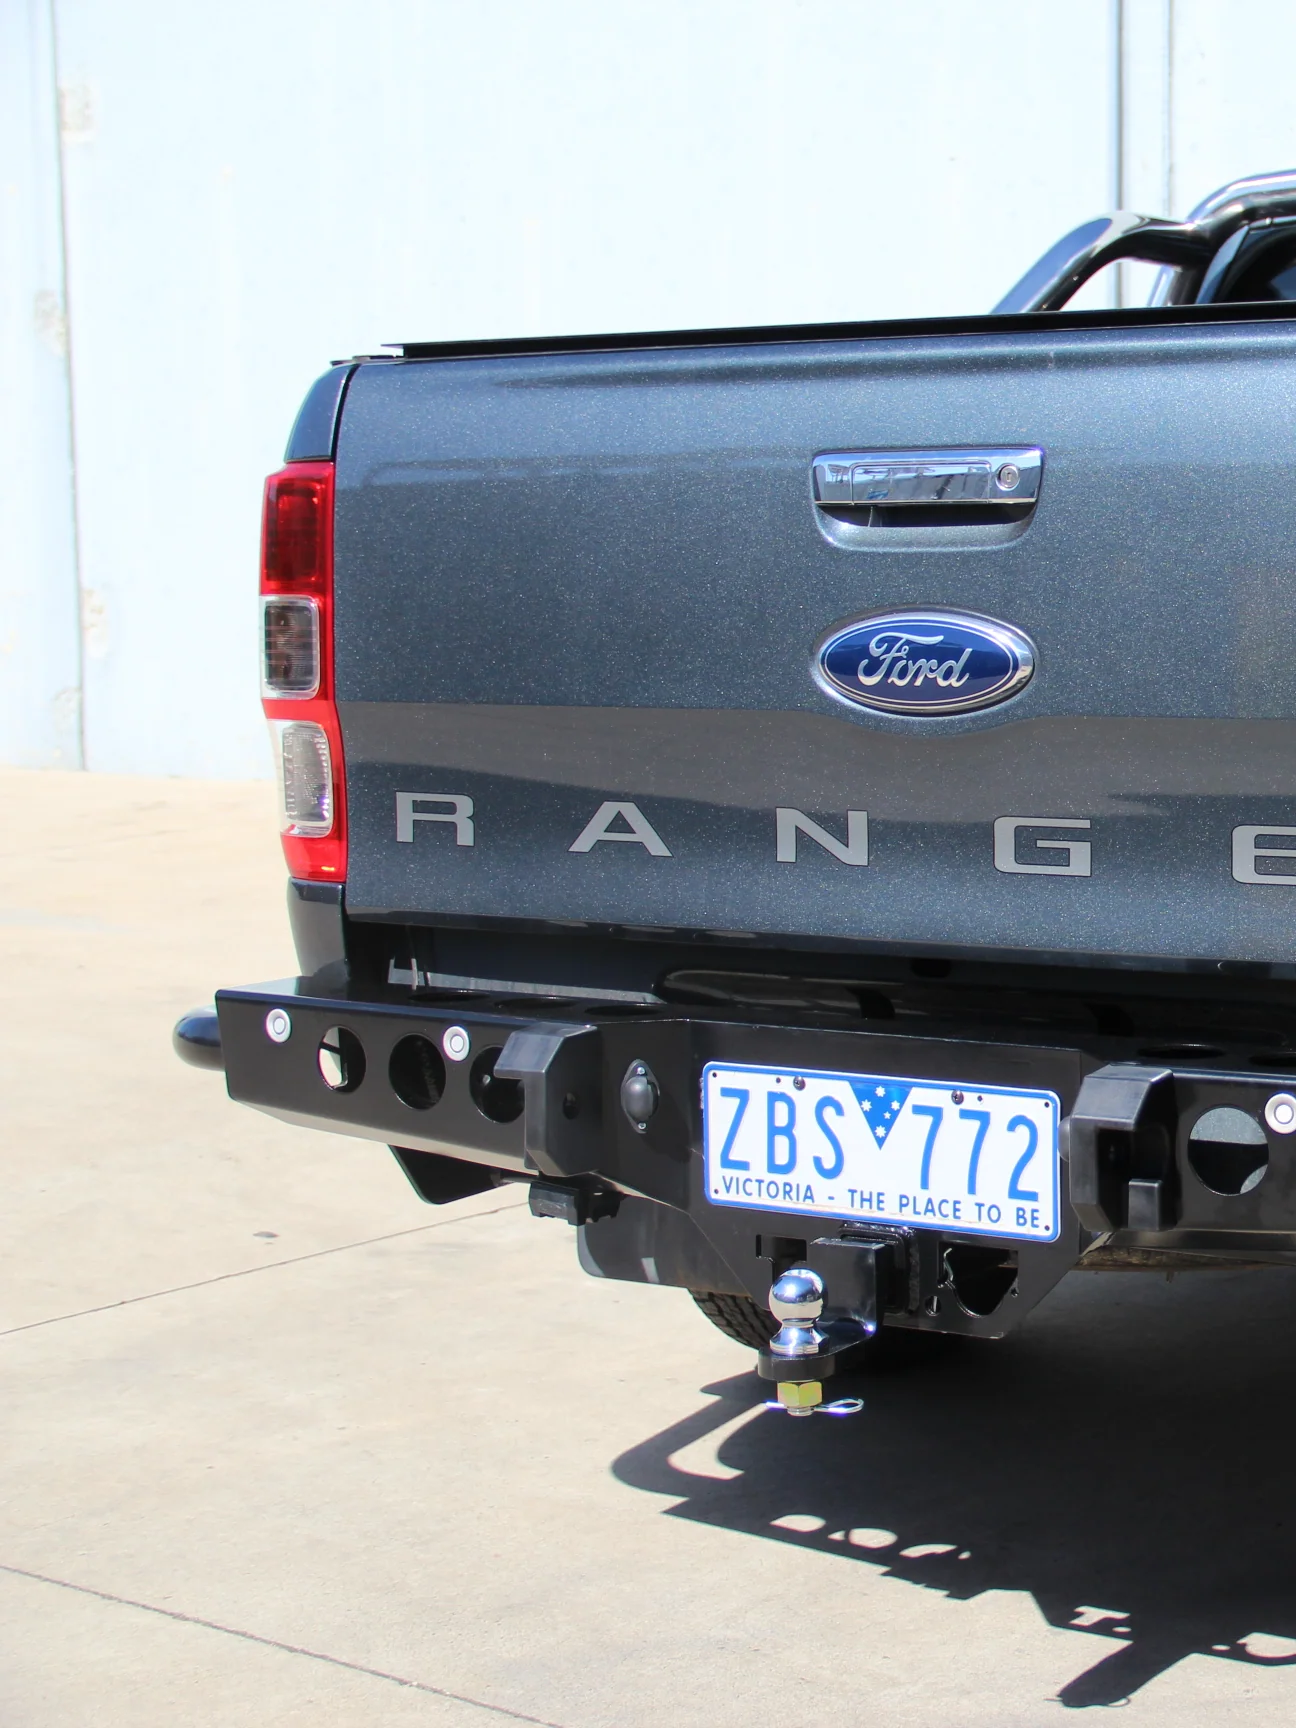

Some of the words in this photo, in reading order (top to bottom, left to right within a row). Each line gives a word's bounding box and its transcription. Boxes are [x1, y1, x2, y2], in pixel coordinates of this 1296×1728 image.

[857, 631, 973, 688] Ford
[719, 1086, 845, 1180] ZBS
[911, 1104, 1040, 1202] 772
[722, 1175, 816, 1203] VICTORIA
[848, 1188, 886, 1212] THE
[899, 1194, 962, 1220] PLACE
[975, 1202, 1002, 1224] TO
[1016, 1206, 1041, 1229] BE
